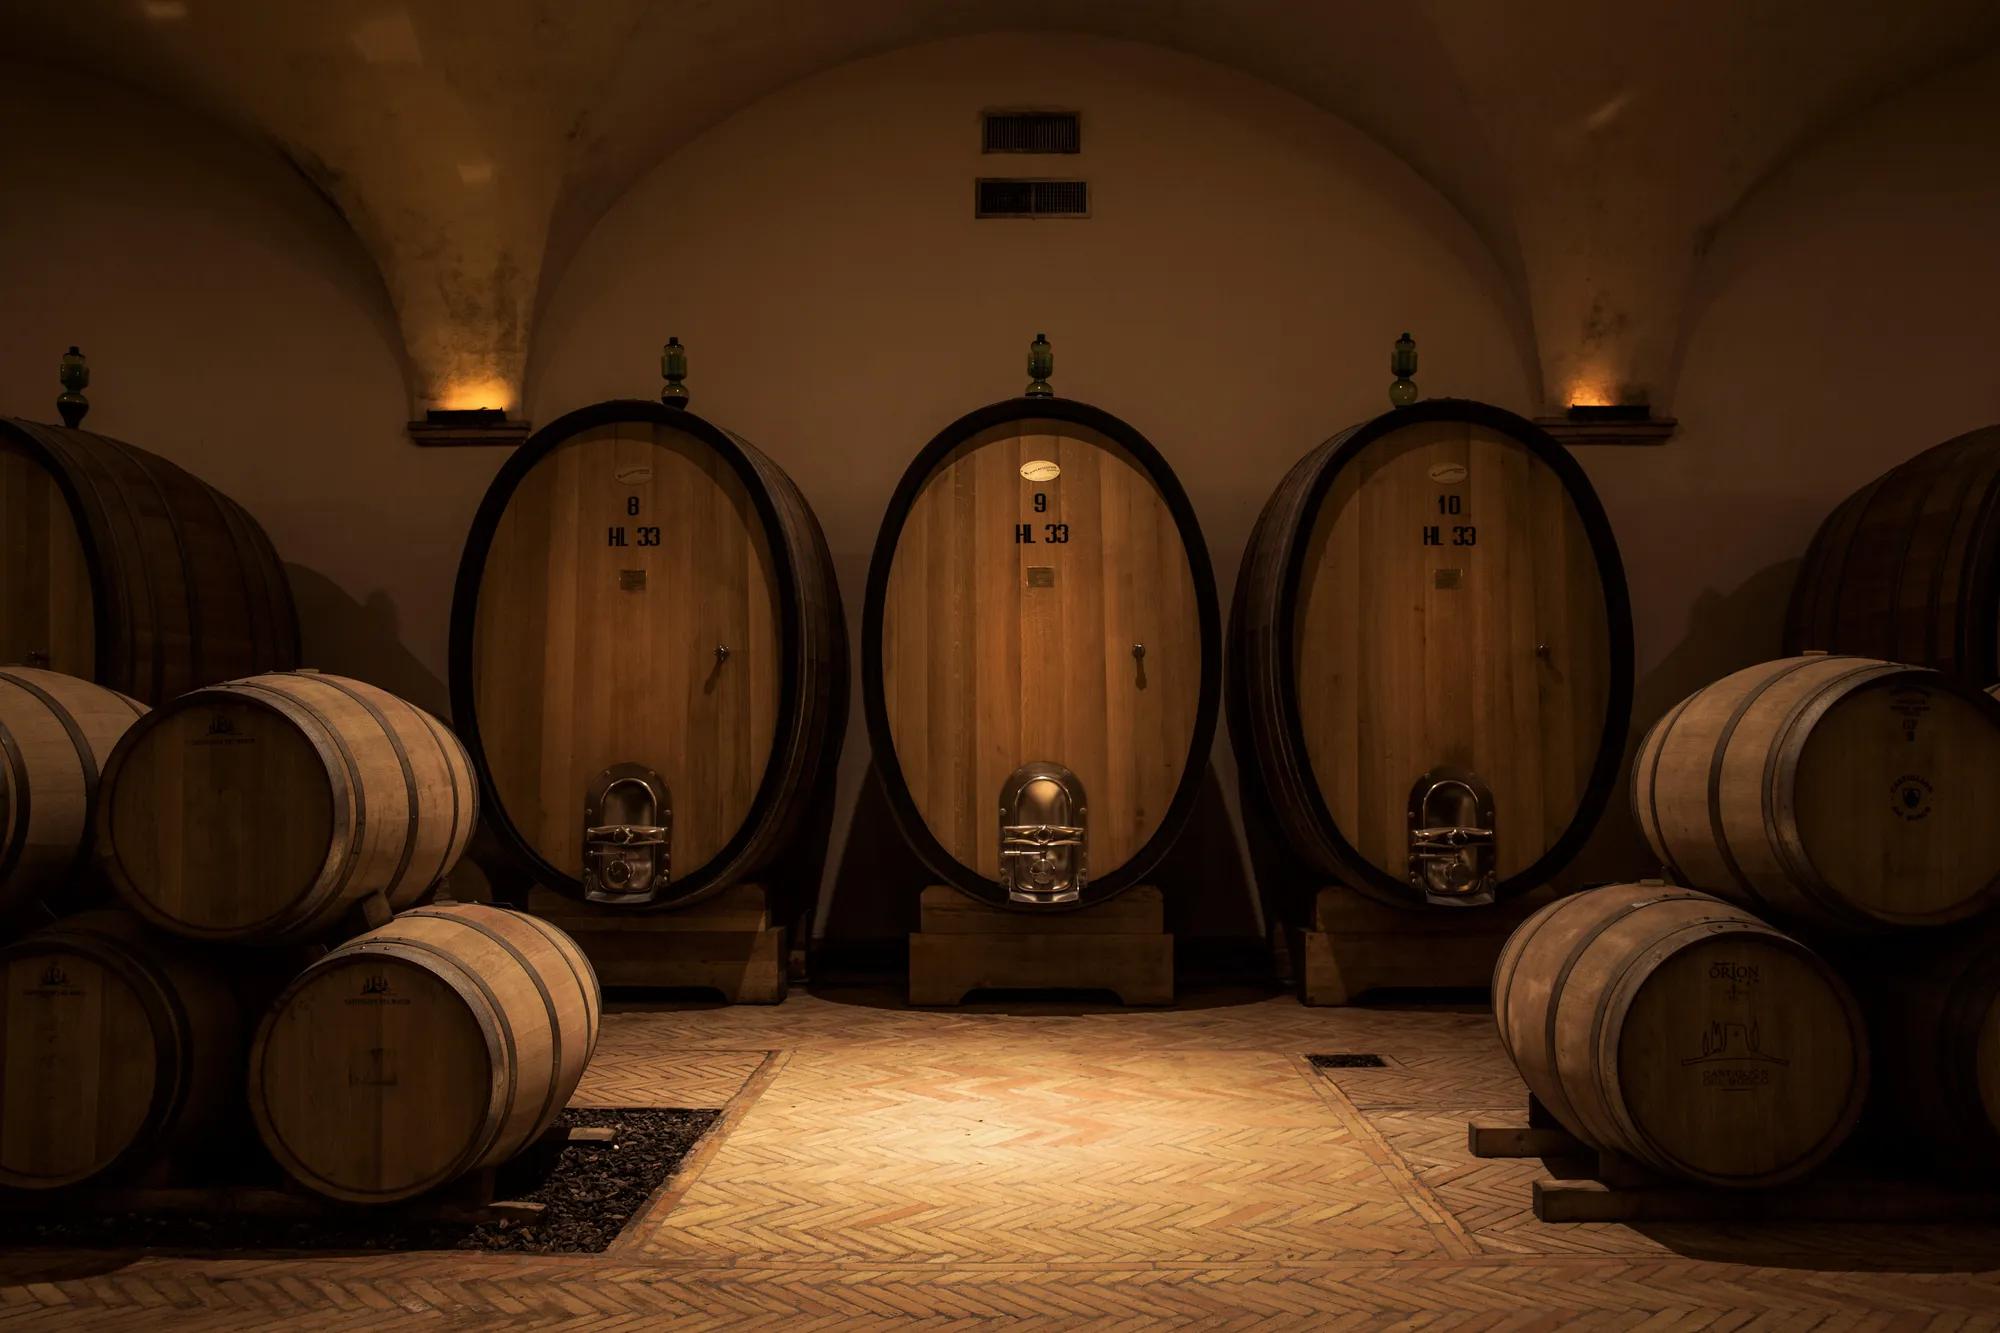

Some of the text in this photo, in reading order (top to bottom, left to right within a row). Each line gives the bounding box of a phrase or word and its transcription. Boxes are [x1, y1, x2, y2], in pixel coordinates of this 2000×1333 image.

[627, 496, 639, 516] 8
[1034, 493, 1047, 513] 9
[1438, 495, 1461, 515] 10
[608, 527, 660, 547] HL 33
[1015, 524, 1069, 544] HL 33
[1423, 526, 1476, 546] HL 33
